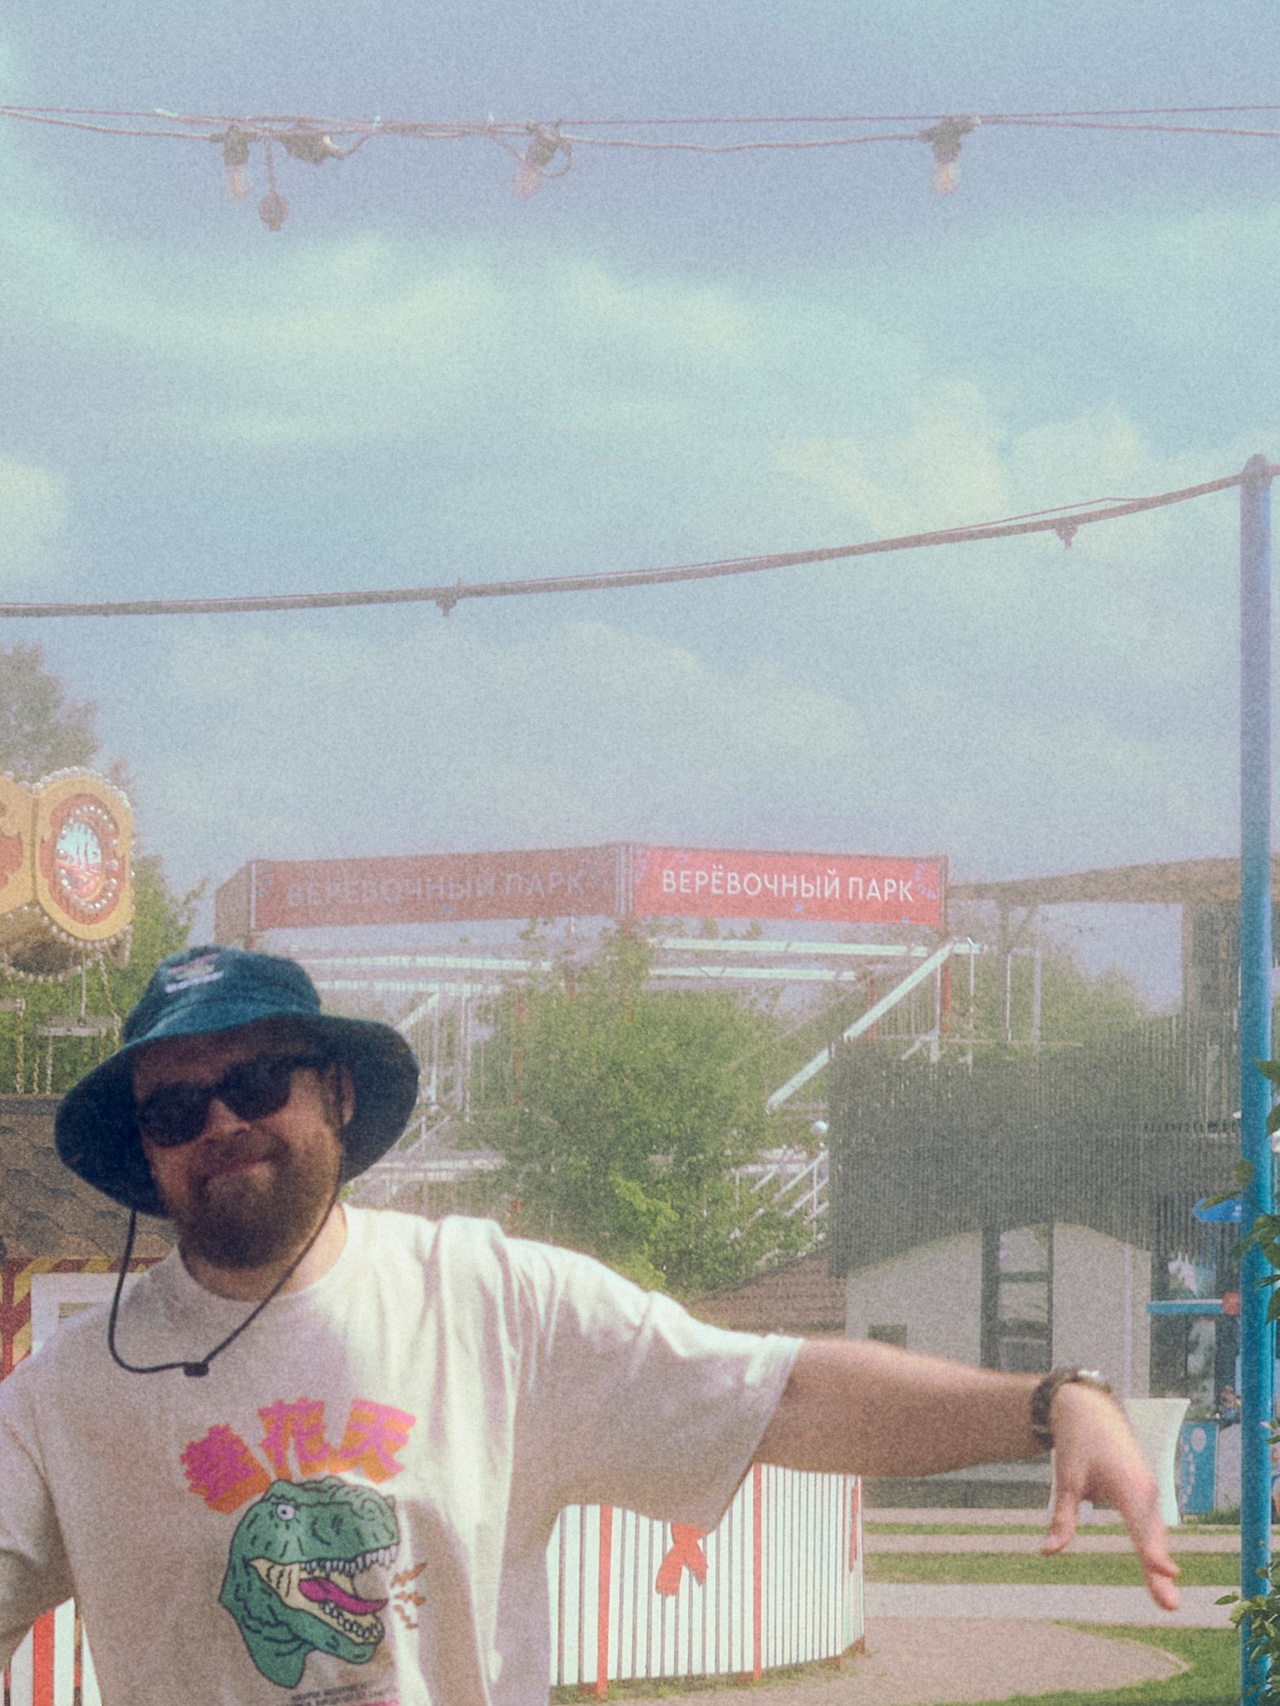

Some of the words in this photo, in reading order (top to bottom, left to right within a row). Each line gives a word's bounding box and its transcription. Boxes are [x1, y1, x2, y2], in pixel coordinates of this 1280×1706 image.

[504, 869, 585, 899] ПАРК
[662, 863, 840, 899] ВЕРЁВОЧНЫЙ
[848, 876, 914, 901] ПАРК
